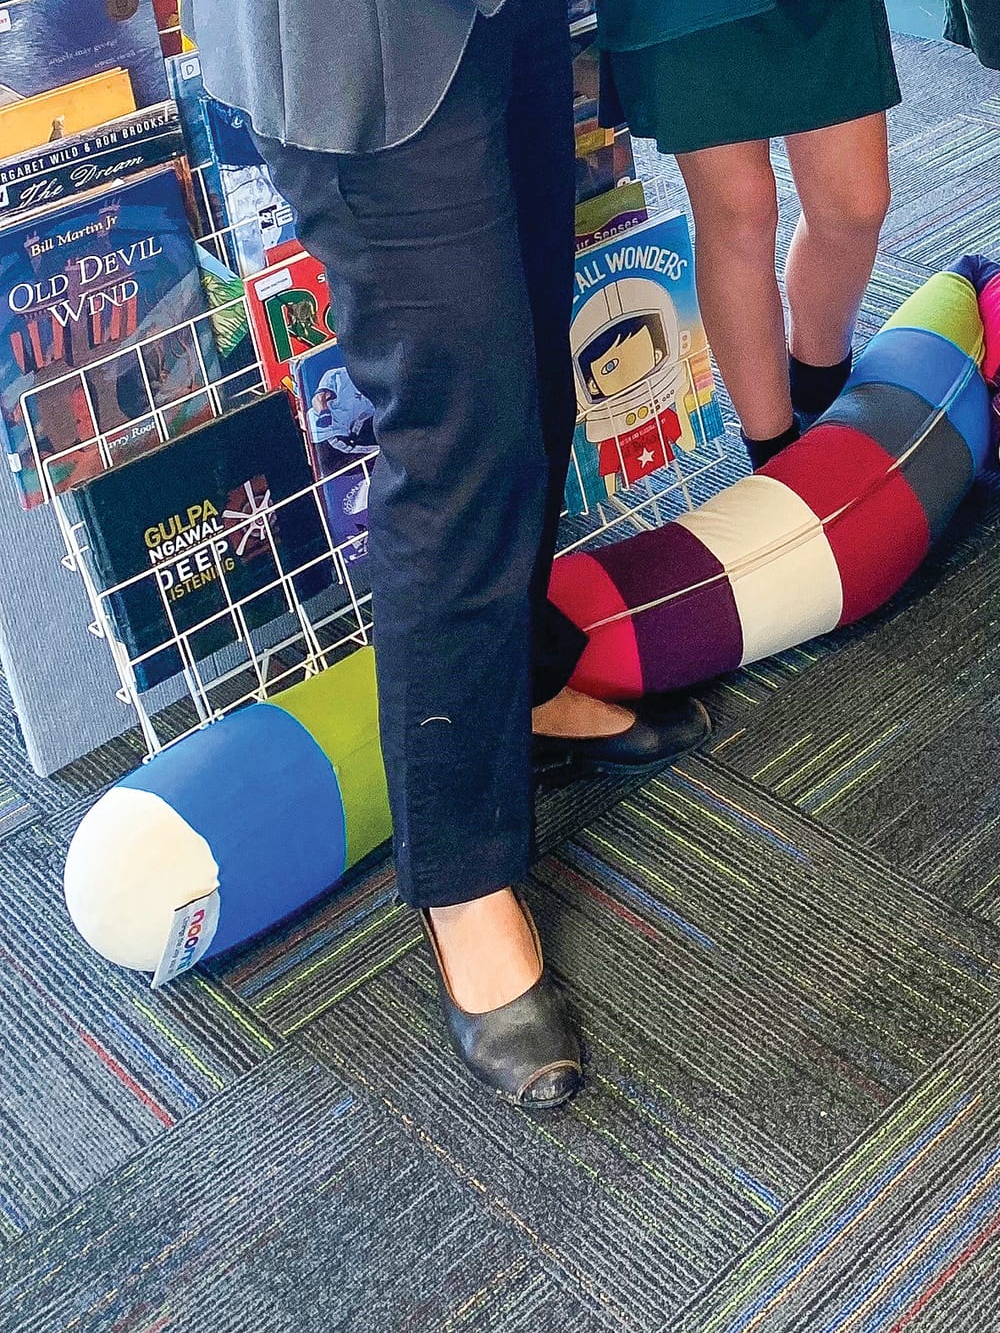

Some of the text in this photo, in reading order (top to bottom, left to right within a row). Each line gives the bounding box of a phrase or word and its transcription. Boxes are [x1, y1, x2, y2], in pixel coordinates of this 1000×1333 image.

[186, 64, 194, 75] D
[49, 147, 79, 166] WILD
[83, 143, 91, 153] &
[96, 132, 118, 149] RON
[122, 116, 164, 139] BROOKS
[19, 155, 145, 208] The Dream
[30, 215, 119, 258] Bill Martin Jr
[593, 216, 641, 243] Senses
[7, 236, 163, 314] OLD DEVIL
[574, 244, 688, 294] ALL WONDERS
[47, 278, 140, 328] WIND
[143, 499, 220, 548] GULPA
[149, 517, 225, 565] NGAWAL
[158, 539, 229, 591] DEEP
[168, 557, 236, 604] ISTENIG
